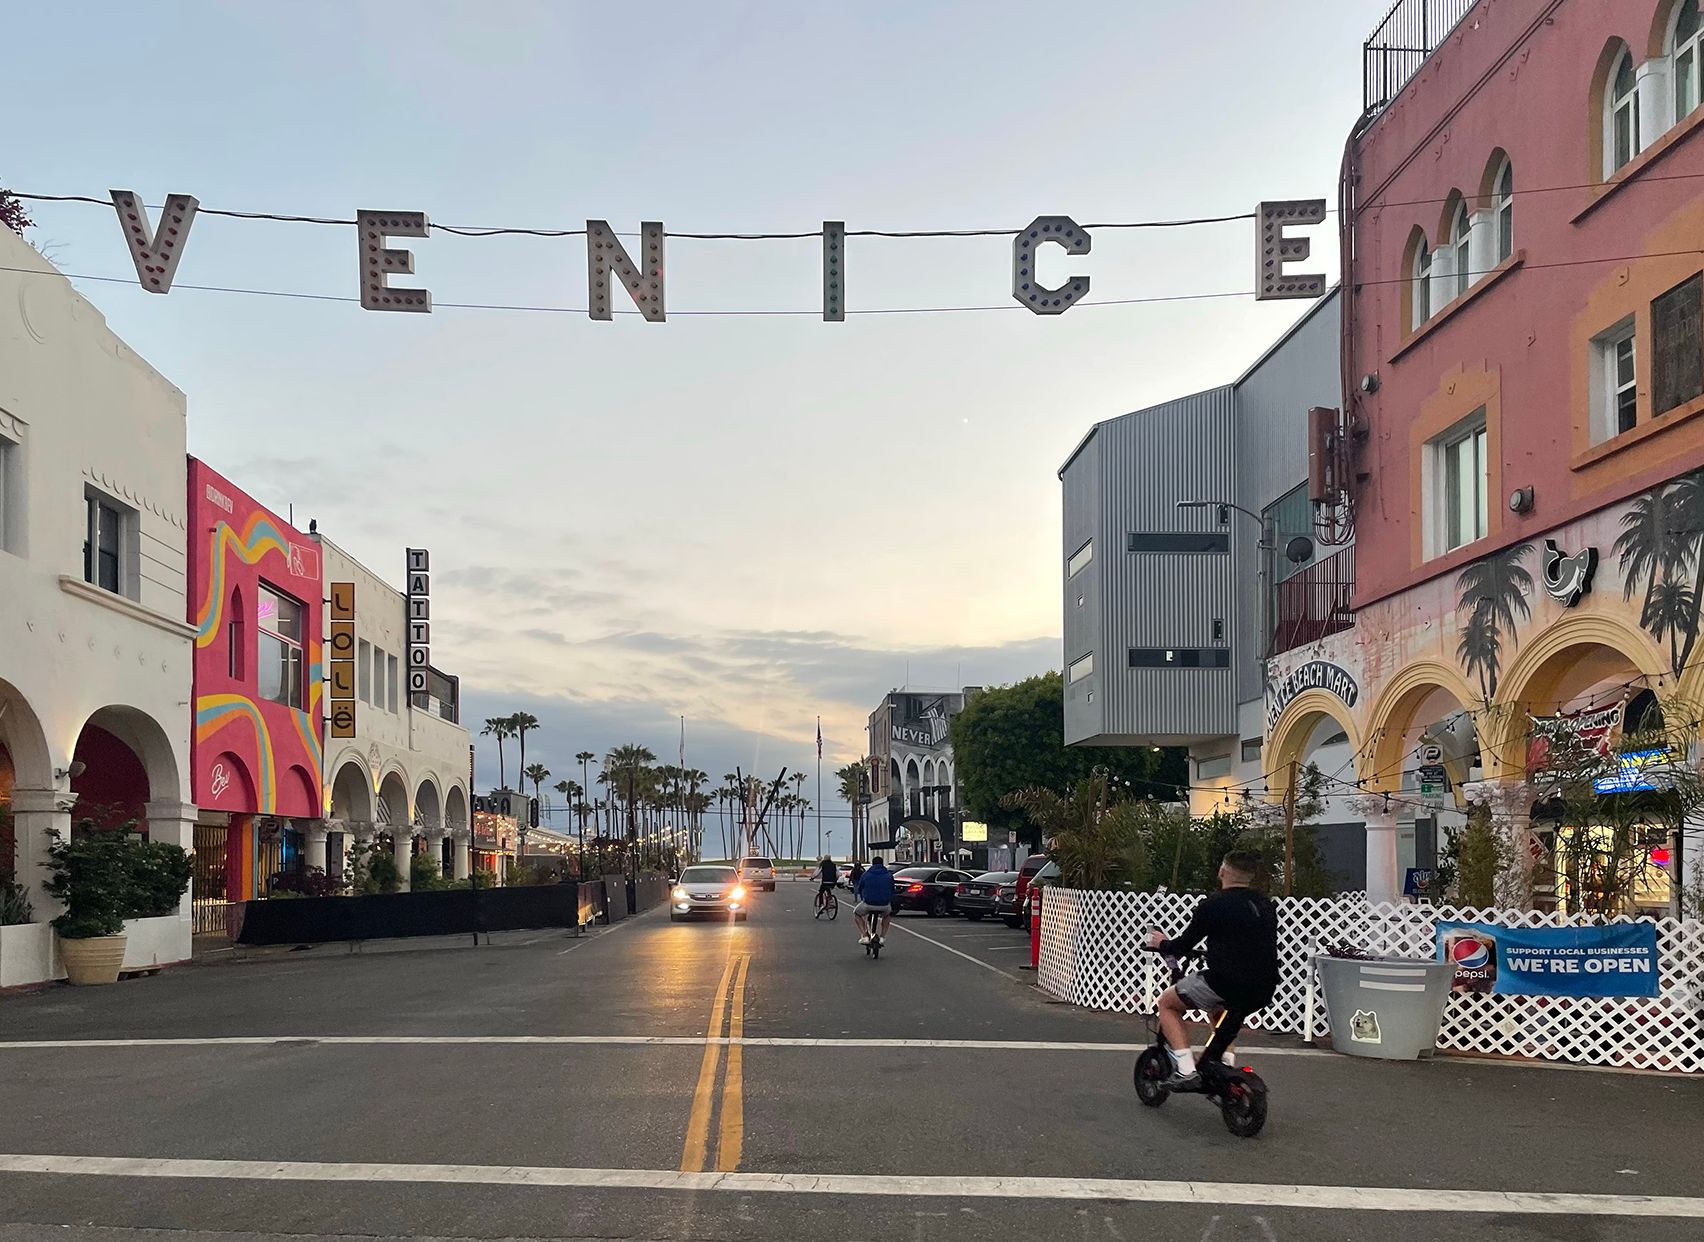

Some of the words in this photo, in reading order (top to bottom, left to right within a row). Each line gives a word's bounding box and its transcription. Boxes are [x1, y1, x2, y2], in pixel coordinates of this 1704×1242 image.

[110, 189, 1326, 322] VENICE
[411, 552, 425, 689] TATTOO
[1292, 664, 1323, 693] BEACH
[1326, 666, 1355, 705] MART
[892, 725, 931, 745] NEVER
[1506, 947, 1551, 955] SUPPORT
[1553, 948, 1586, 956] LOCAL
[1587, 947, 1649, 955] BUSINESSES
[1455, 969, 1488, 980] pepsi
[1507, 957, 1580, 973] WE'RE
[1584, 958, 1650, 973] OPEN
